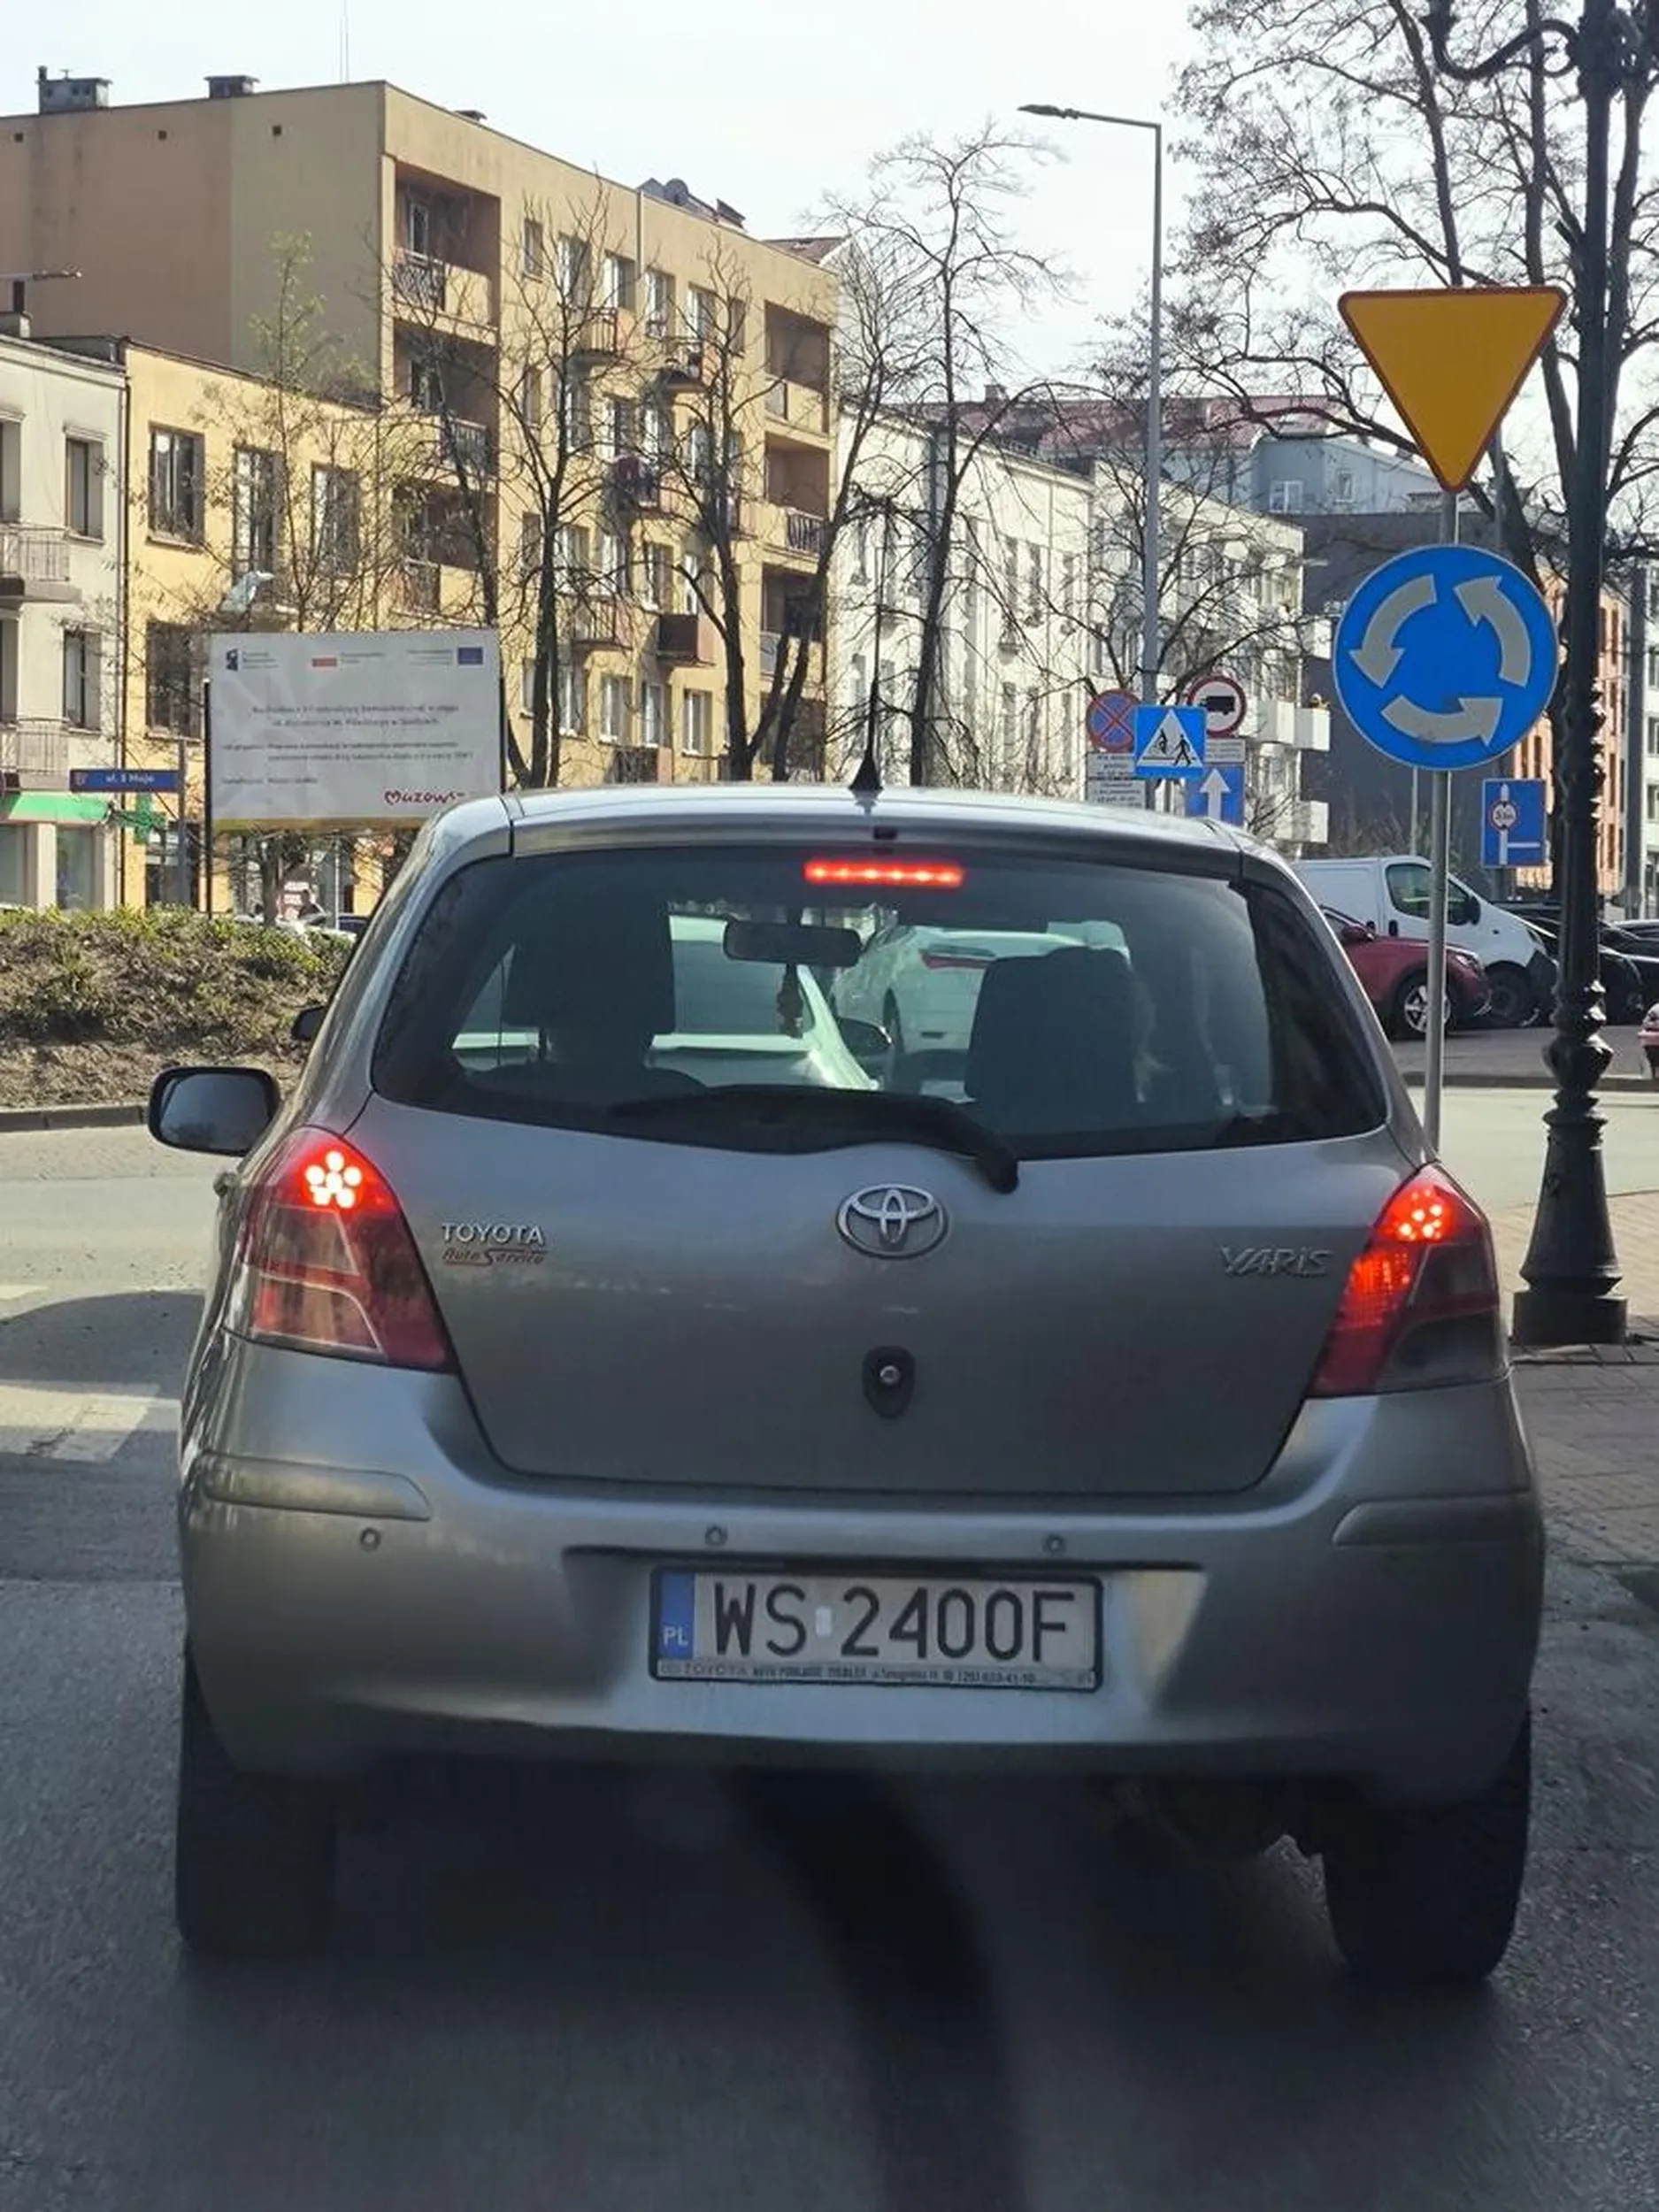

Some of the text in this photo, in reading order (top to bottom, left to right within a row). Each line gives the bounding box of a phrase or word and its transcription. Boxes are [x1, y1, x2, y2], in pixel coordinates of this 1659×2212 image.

[442, 1222, 546, 1246] TOYOTA
[1220, 1246, 1334, 1277] YARIS
[714, 1581, 1075, 1663] WS 2400F
[663, 1625, 689, 1647] PL
